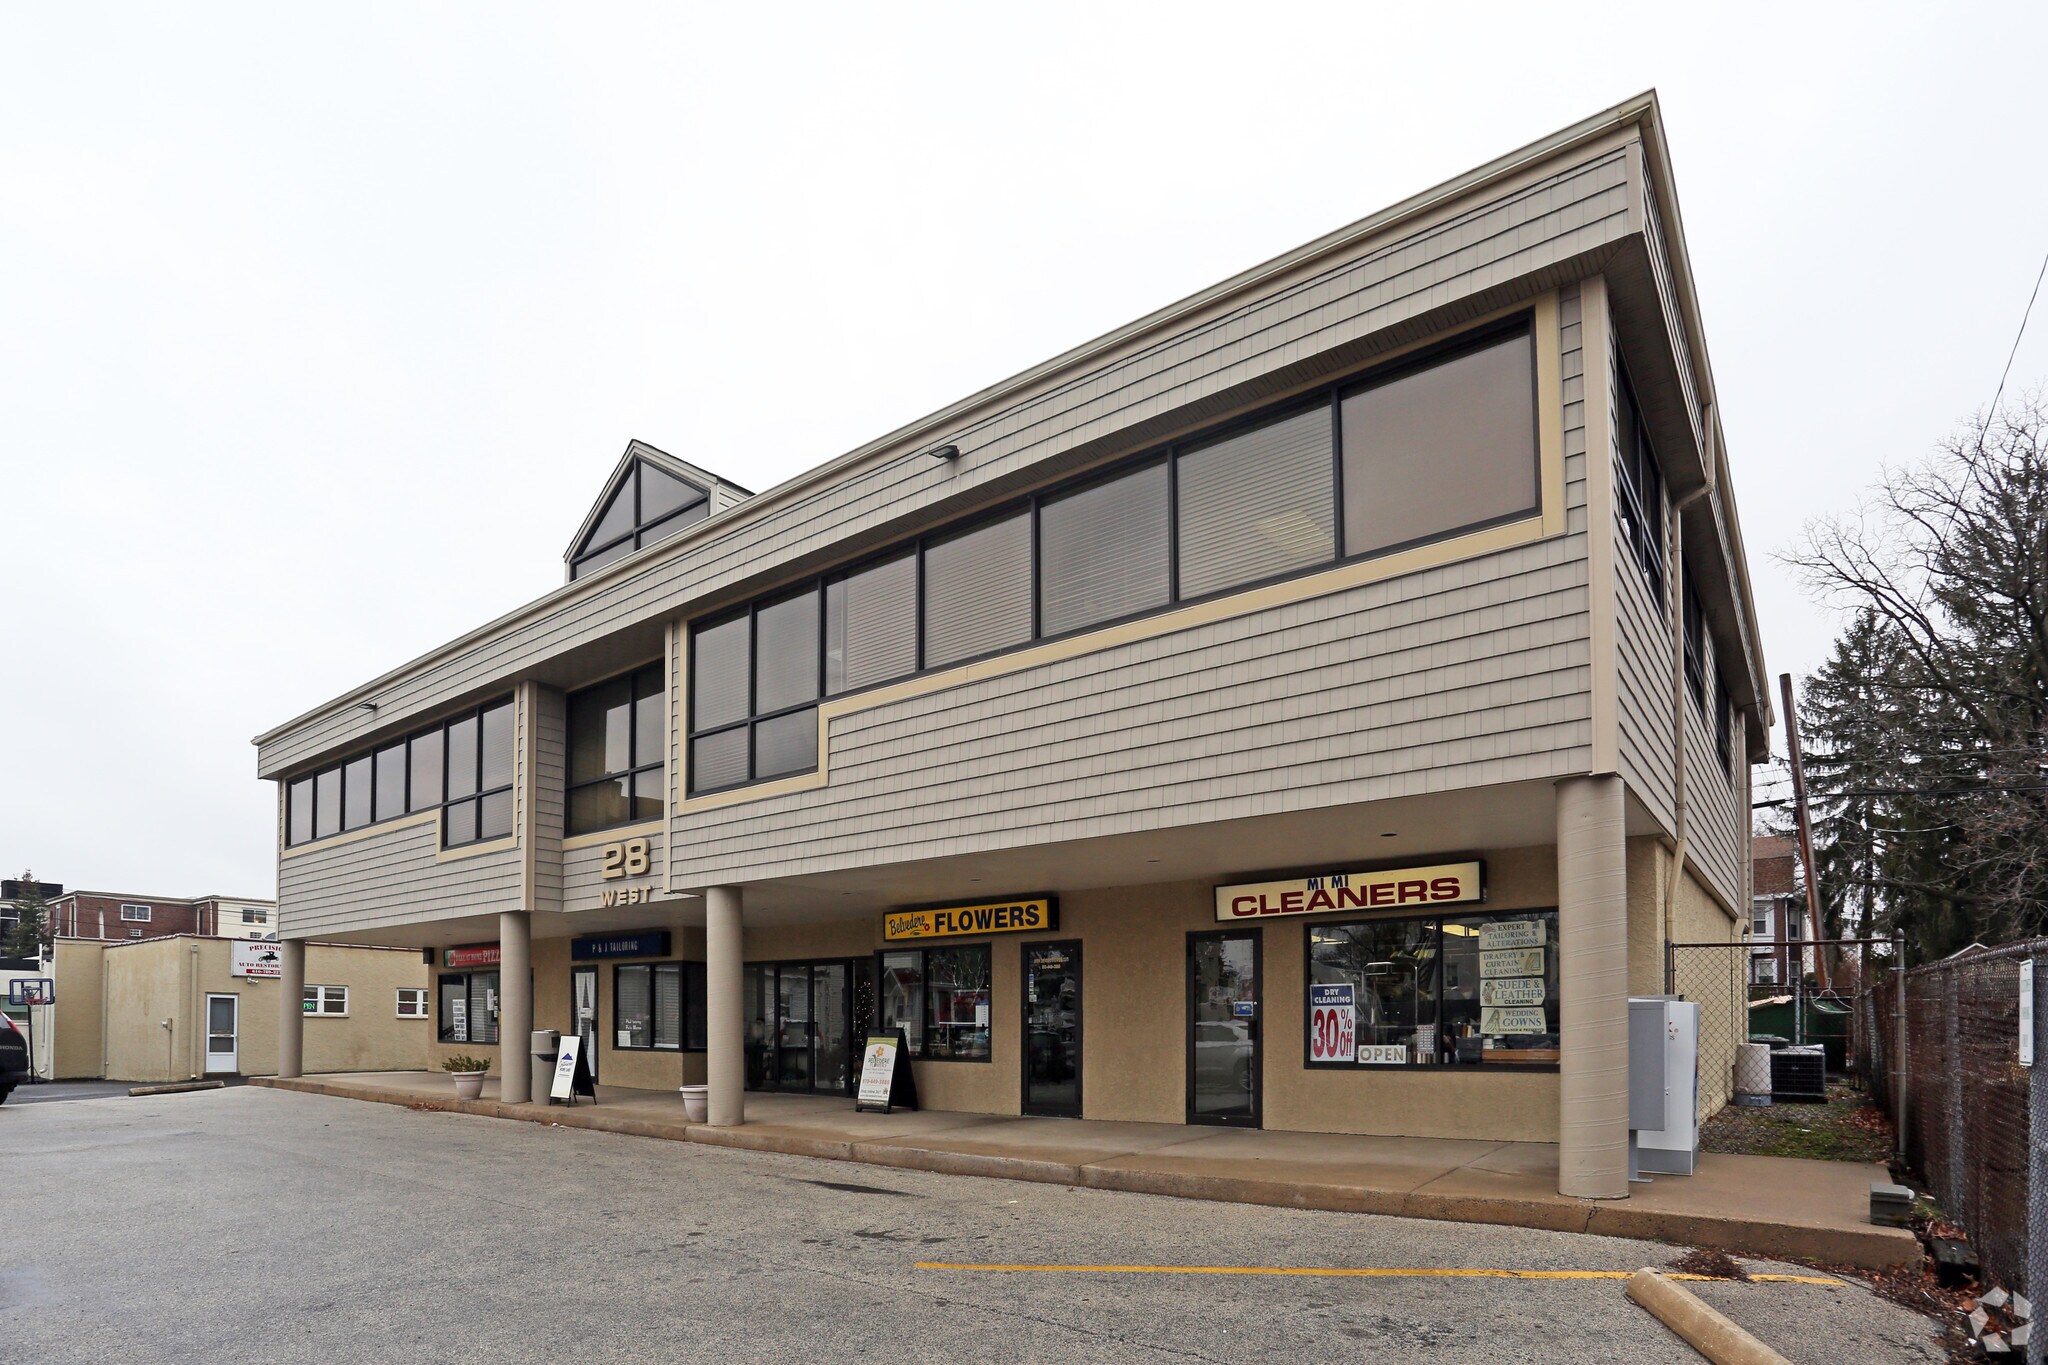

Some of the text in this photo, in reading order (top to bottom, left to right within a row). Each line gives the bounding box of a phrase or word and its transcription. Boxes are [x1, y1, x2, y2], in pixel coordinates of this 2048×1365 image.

[601, 838, 650, 880] 28
[1307, 875, 1349, 891] MI MI
[600, 884, 652, 907] WEST
[1231, 877, 1461, 916] CLEANERS
[889, 904, 1040, 936] Belvedere FLOWERS
[1498, 923, 1526, 932] EXPERT
[1488, 930, 1529, 940] TAILORING
[592, 941, 638, 953] P & J TAILORING
[1487, 938, 1539, 948] ALTERATIONS
[1484, 951, 1517, 961] DRAPERY
[1486, 960, 1519, 968] CURTAIN
[1484, 967, 1523, 976] CLEANING
[1498, 979, 1540, 990] SUEDE &
[1494, 989, 1543, 999] LEATHER
[1314, 996, 1351, 1004] CLEANING
[1502, 1017, 1542, 1027] GOWNS
[1313, 1009, 1352, 1058] 30 %
[1360, 1047, 1403, 1061] OPEN
